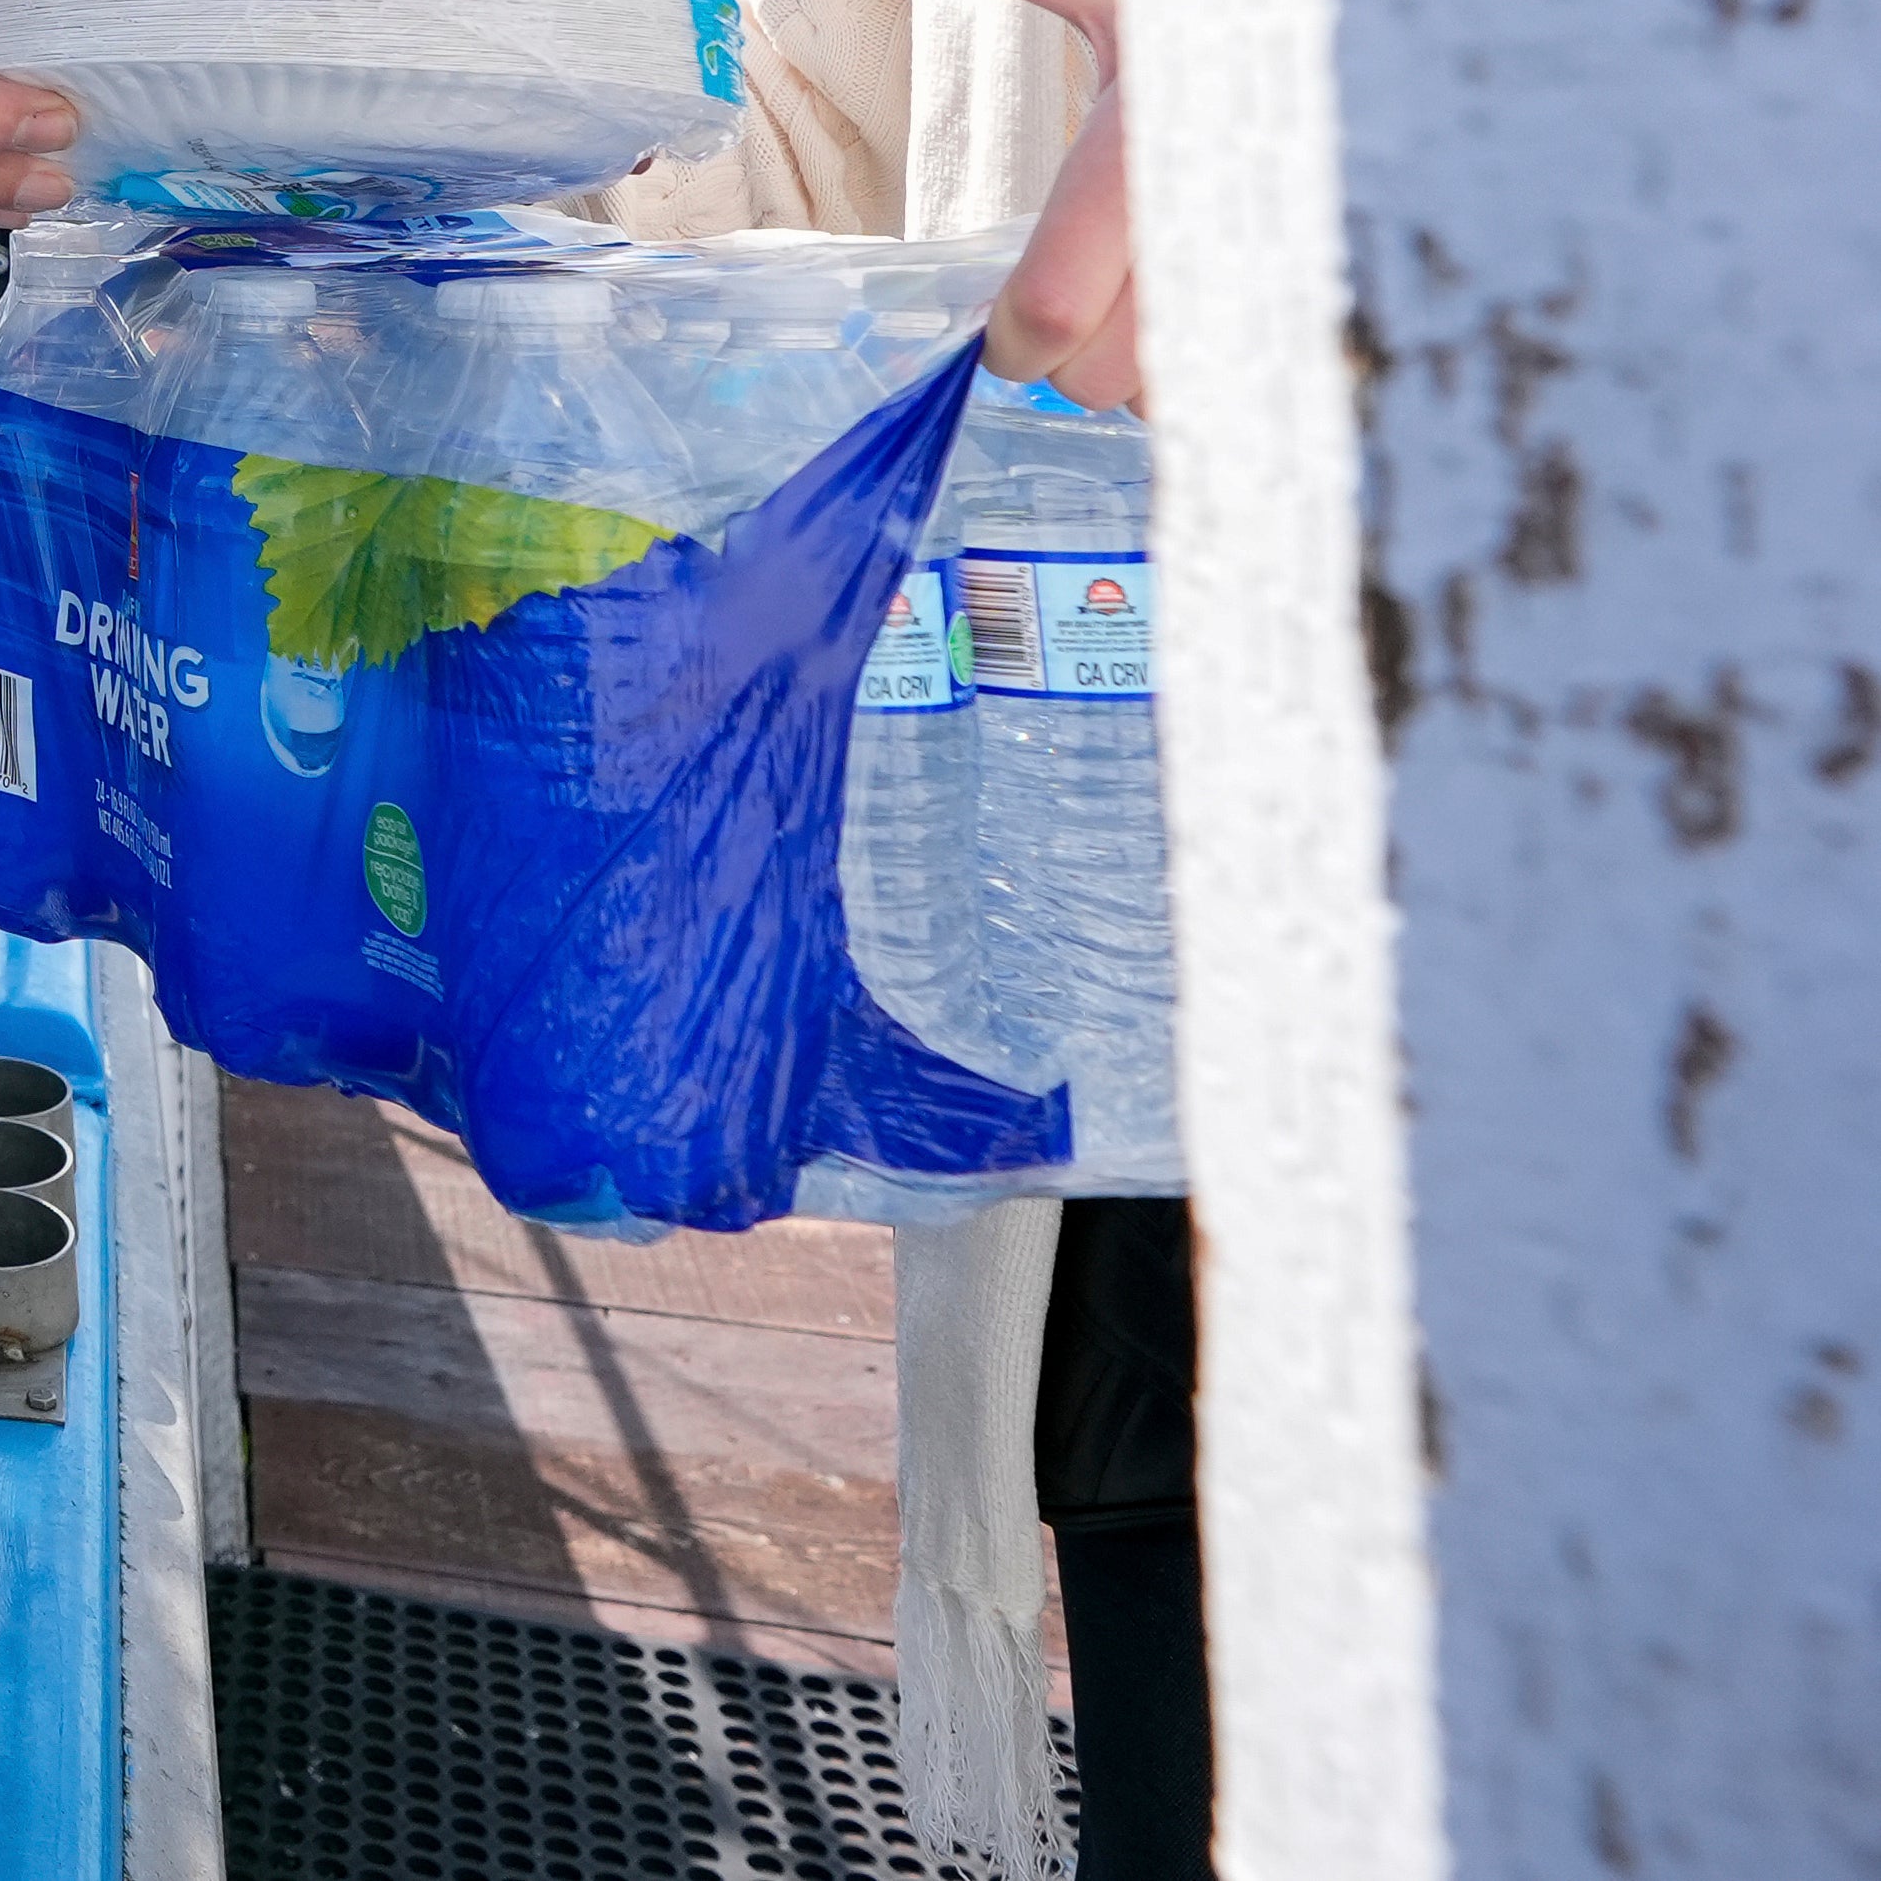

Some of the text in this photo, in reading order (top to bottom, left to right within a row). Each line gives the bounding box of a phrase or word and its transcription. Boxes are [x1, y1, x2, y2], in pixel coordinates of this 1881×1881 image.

[865, 674, 932, 700] CA CRV
[1076, 662, 1104, 687] CA
[22, 784, 29, 795] 2
